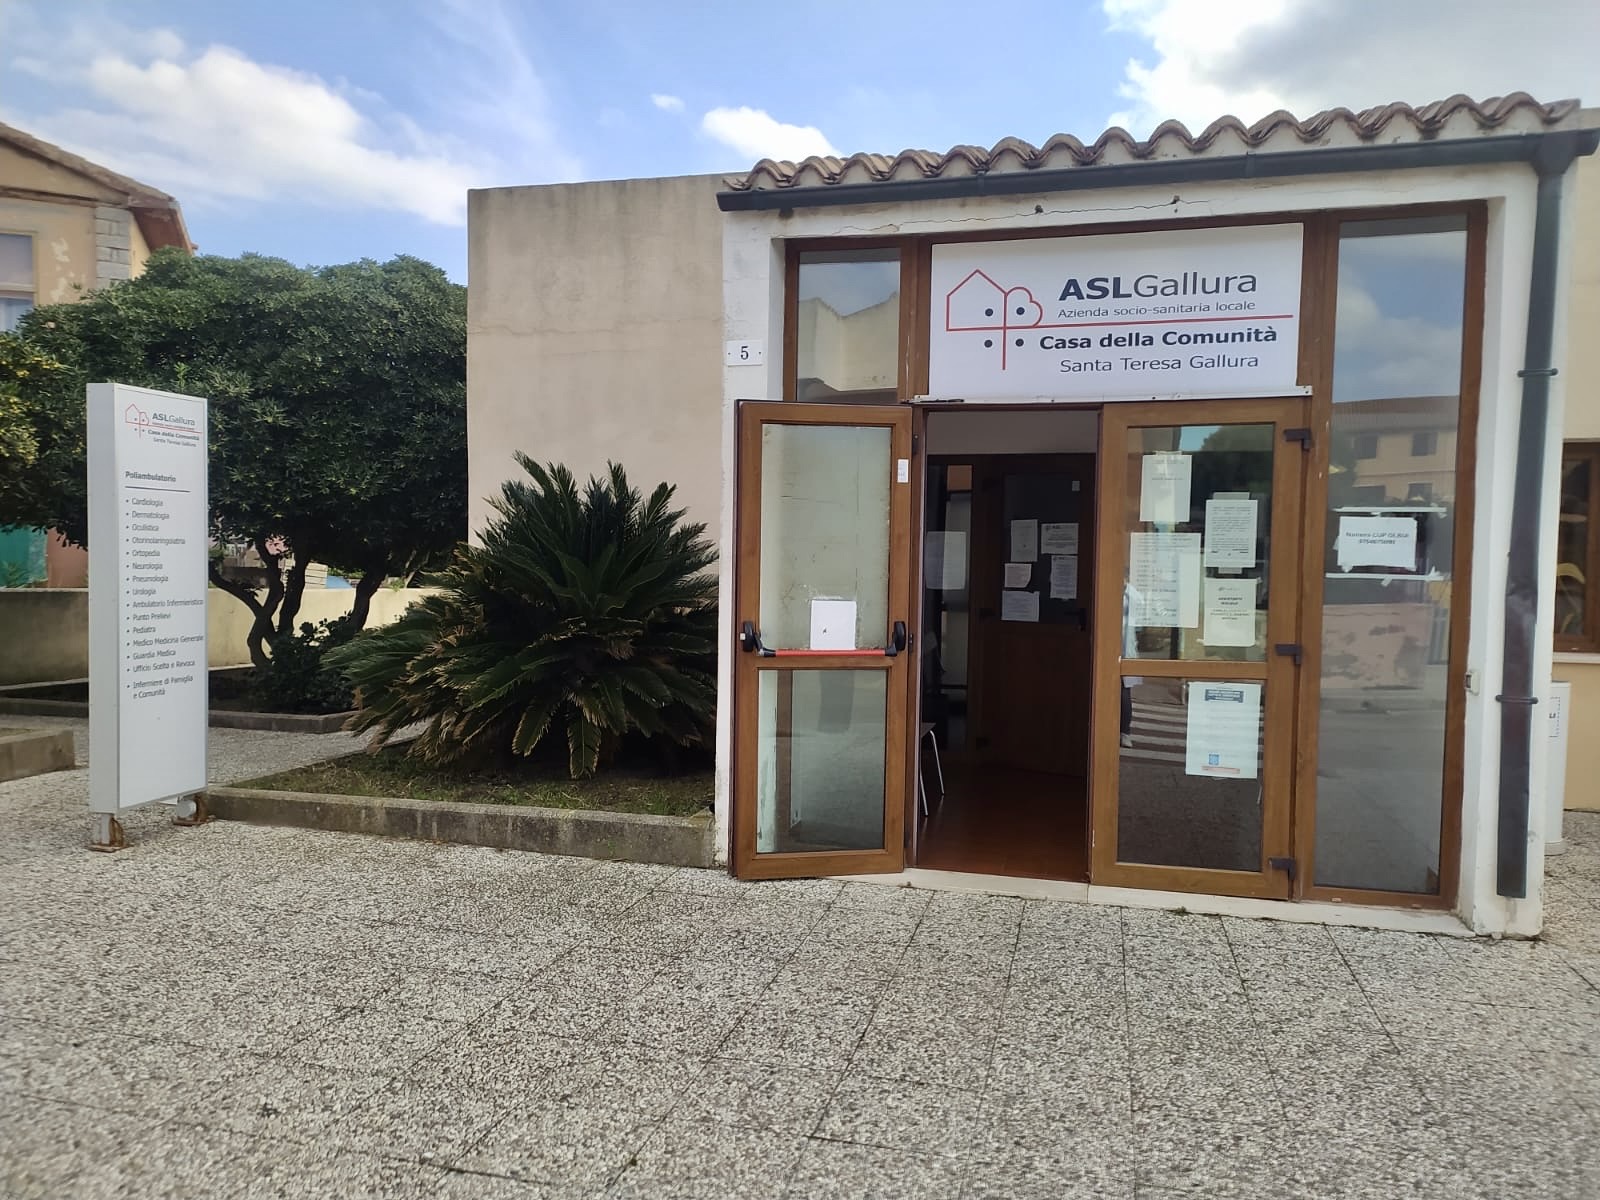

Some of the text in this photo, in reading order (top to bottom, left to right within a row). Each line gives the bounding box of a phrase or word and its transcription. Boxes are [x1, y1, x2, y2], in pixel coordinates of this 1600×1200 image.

[1058, 300, 1256, 318] Azienda socio-sanitaria locale
[1039, 326, 1277, 350] Casa della Comunità
[740, 345, 749, 360] 5
[1060, 353, 1259, 373] Santa Teresa Gallura
[125, 470, 176, 482] Poliambulatorio
[132, 498, 163, 507] Cardiologia
[132, 510, 170, 520] Dermatologia
[132, 562, 163, 570] Neurologia
[132, 576, 168, 584] Pneumologia
[132, 588, 156, 596] Urologia
[133, 638, 154, 646] Medico
[133, 652, 156, 660] Guardia
[133, 664, 152, 672] Ufficio
[170, 675, 194, 684] Famiglia
[138, 688, 166, 698] Comunità
